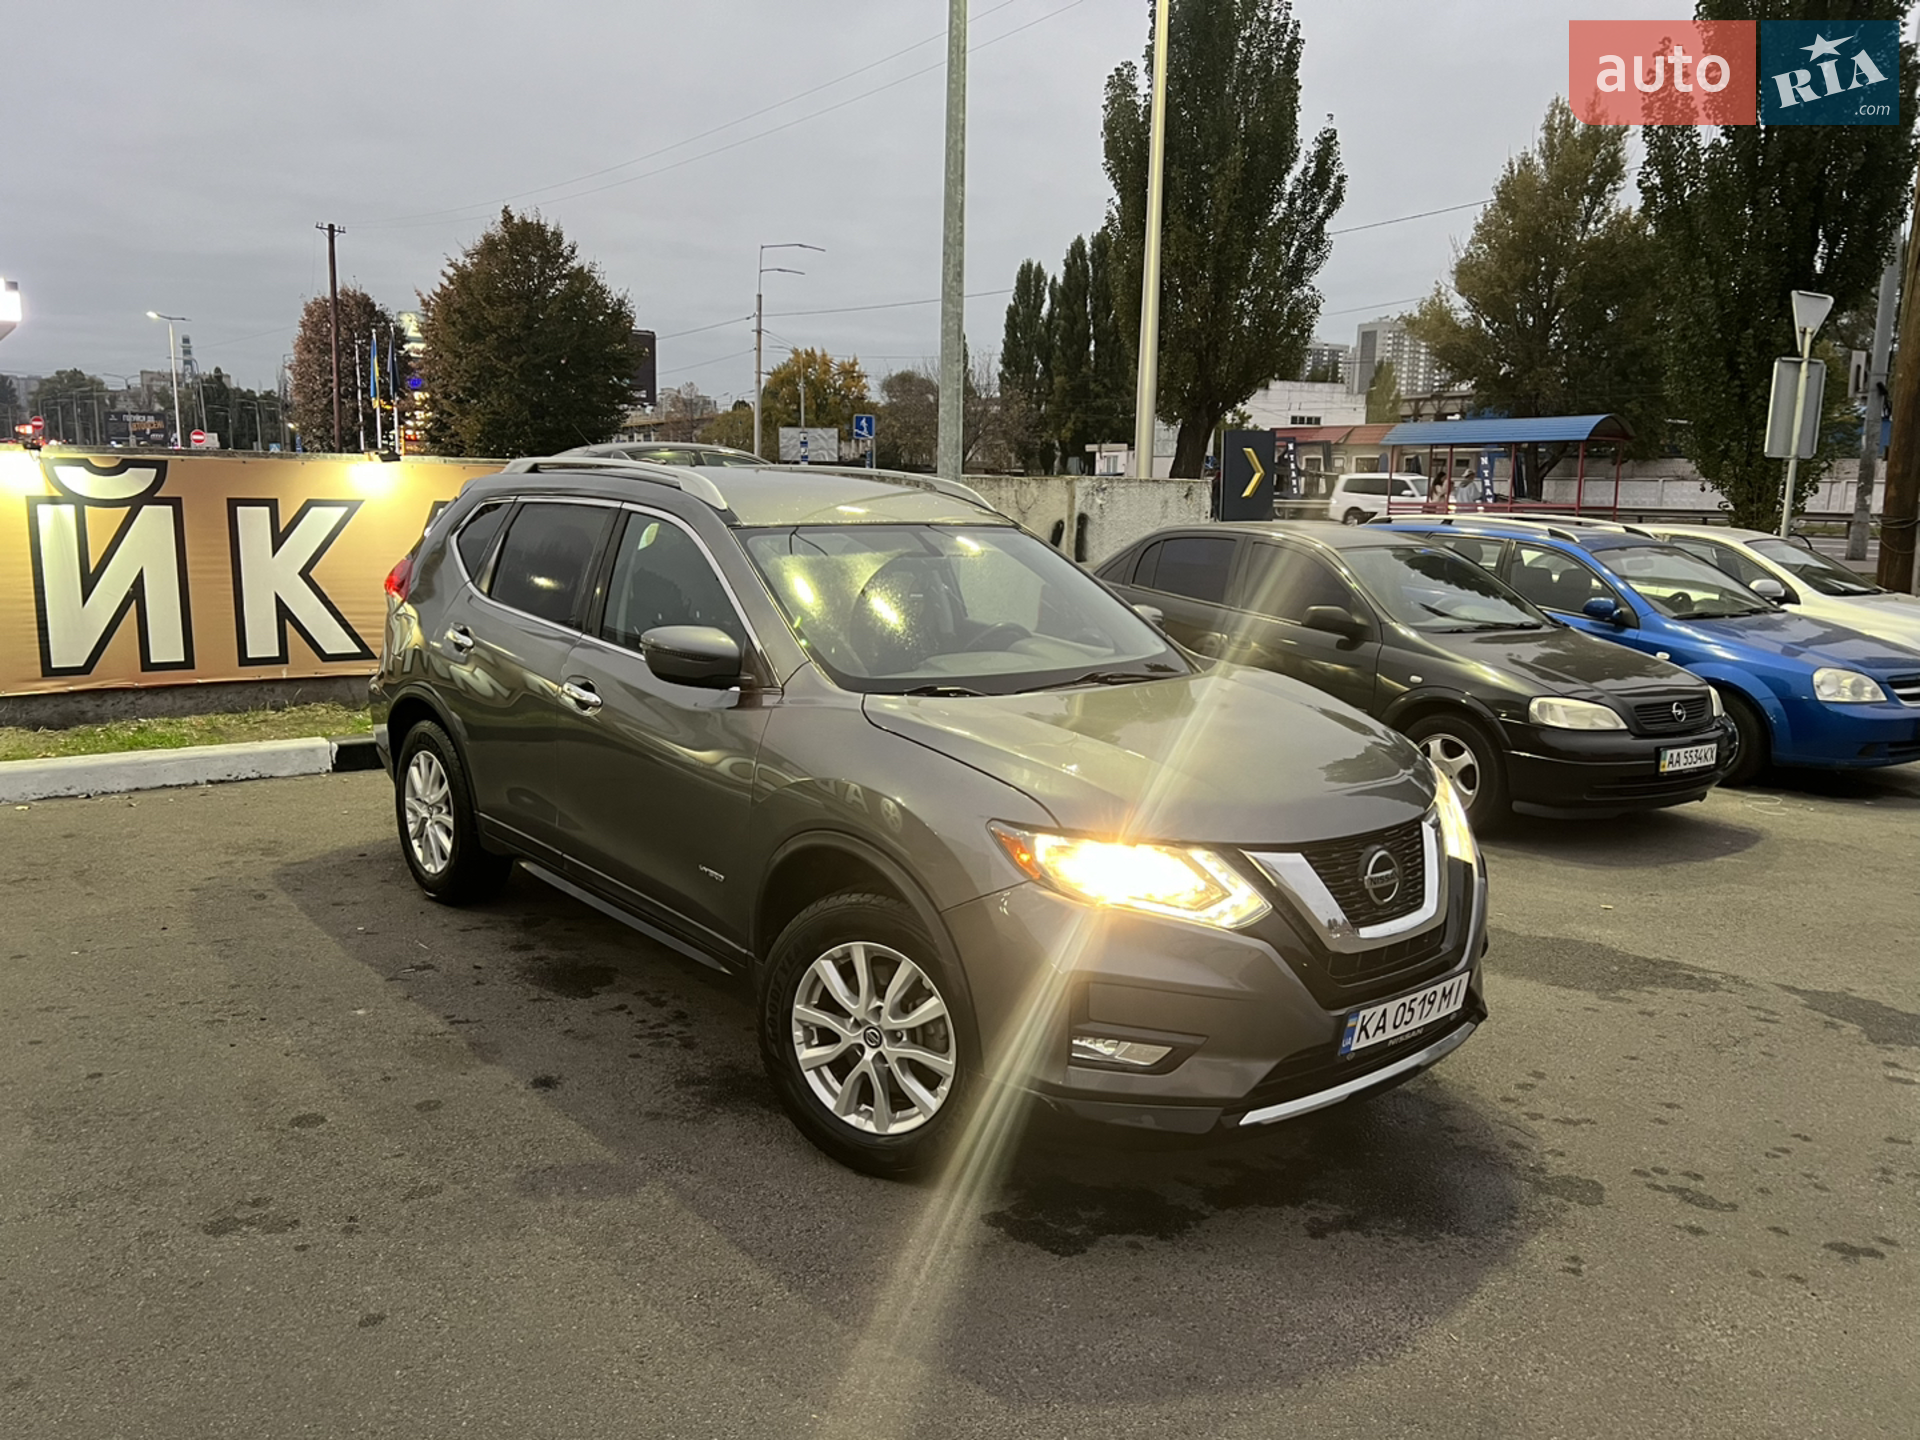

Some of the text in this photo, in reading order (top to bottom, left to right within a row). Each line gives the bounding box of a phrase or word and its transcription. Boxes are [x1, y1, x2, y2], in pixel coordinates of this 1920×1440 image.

[25, 459, 456, 677] ЙК
[1356, 979, 1462, 1044] KA 0519 MI
